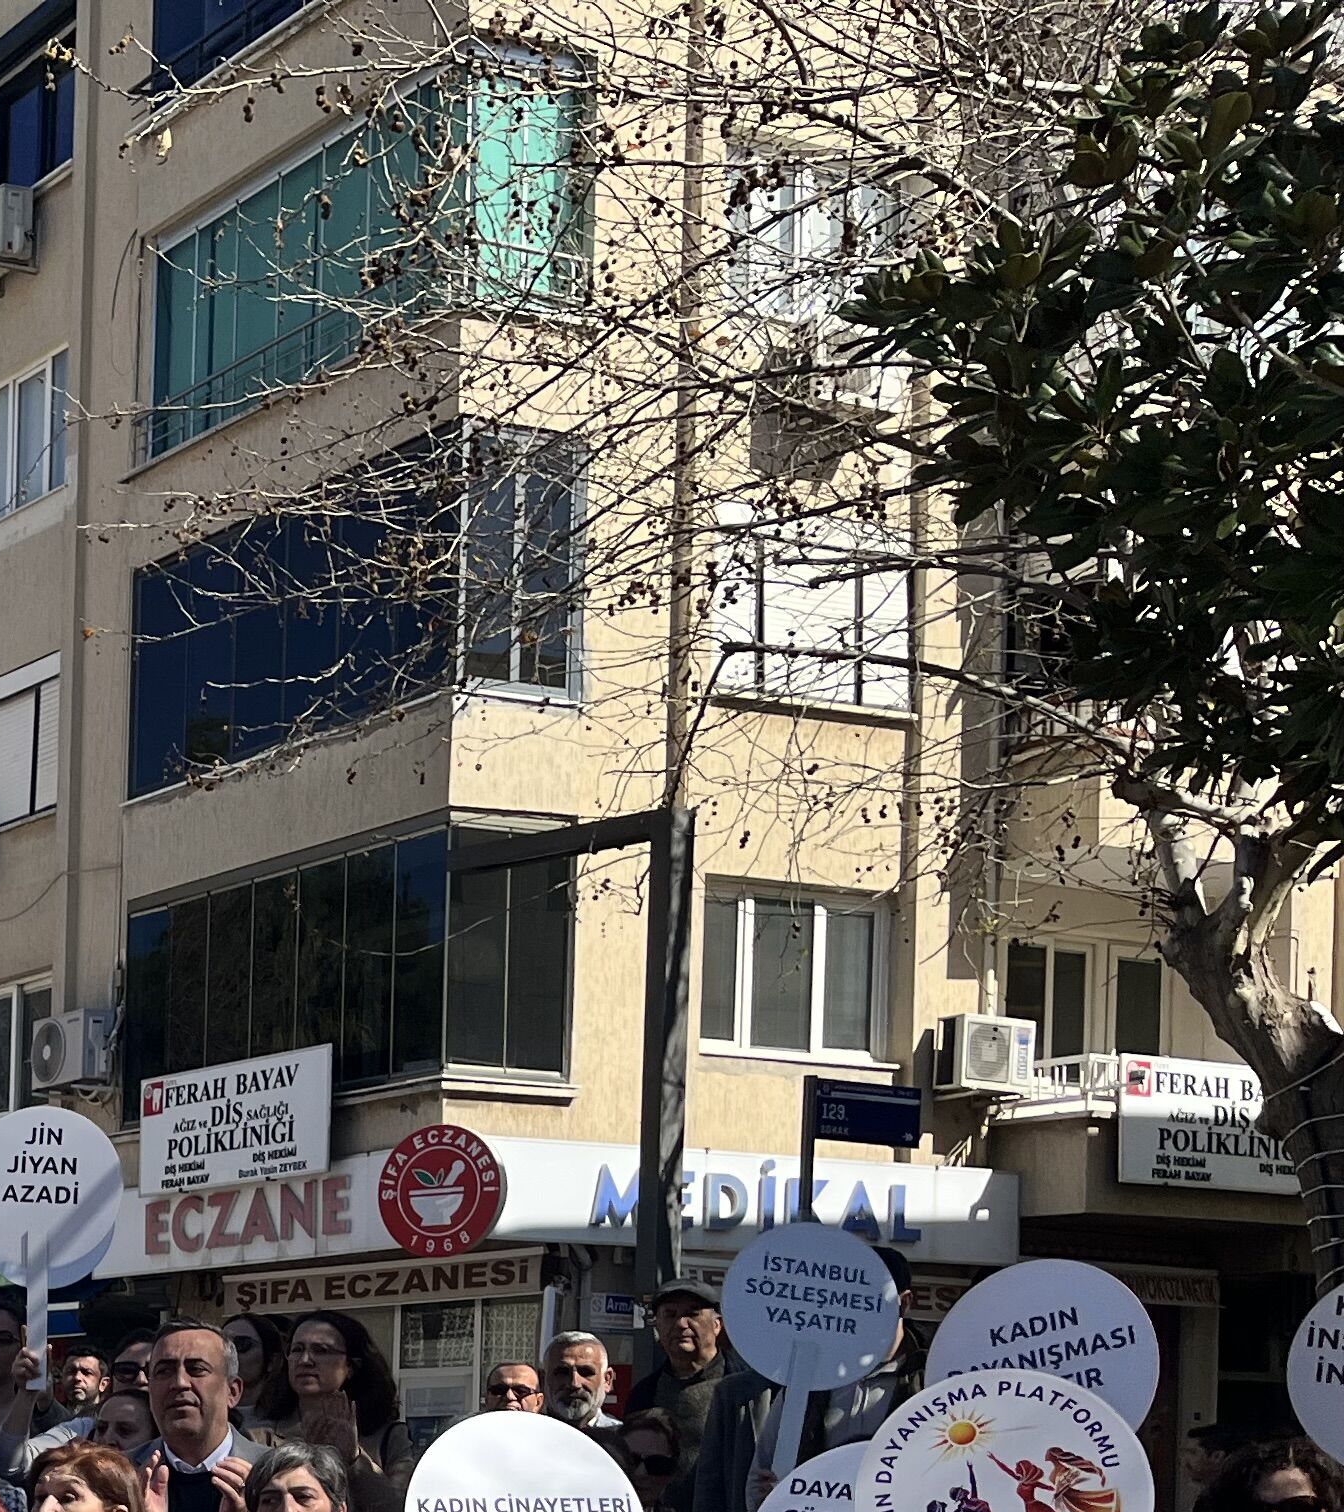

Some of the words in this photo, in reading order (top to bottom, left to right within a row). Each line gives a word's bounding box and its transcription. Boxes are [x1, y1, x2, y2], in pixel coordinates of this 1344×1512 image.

[164, 1077, 227, 1109] FERAH
[236, 1064, 299, 1096] BAYAV
[1155, 1071, 1231, 1099] FERAH
[173, 1118, 197, 1133] AĞIZ
[211, 1098, 243, 1129] DİŞ
[1213, 1101, 1250, 1133] DİŞ
[24, 1122, 64, 1145] JİN
[167, 1114, 295, 1160] POLİKLİNİĞİ
[6, 1152, 78, 1175] JİYAN
[381, 1152, 408, 1200] ŞİFA
[412, 1129, 500, 1192] ECZANESİ
[1, 1180, 81, 1206] AZADİ
[145, 1175, 352, 1256] ECZANE
[410, 1231, 470, 1253] 1968
[235, 1279, 313, 1311] ŞİFA
[324, 1258, 529, 1301] ECZANESİ
[762, 1251, 871, 1286] İSTANBUL
[745, 1276, 883, 1314] SÖZLEŞMESİ
[765, 1305, 857, 1336] YAŞATIR
[989, 1307, 1079, 1347] KADIN
[875, 1383, 987, 1484] DAYANIŞMA
[998, 1380, 1121, 1468] PLATFORMU
